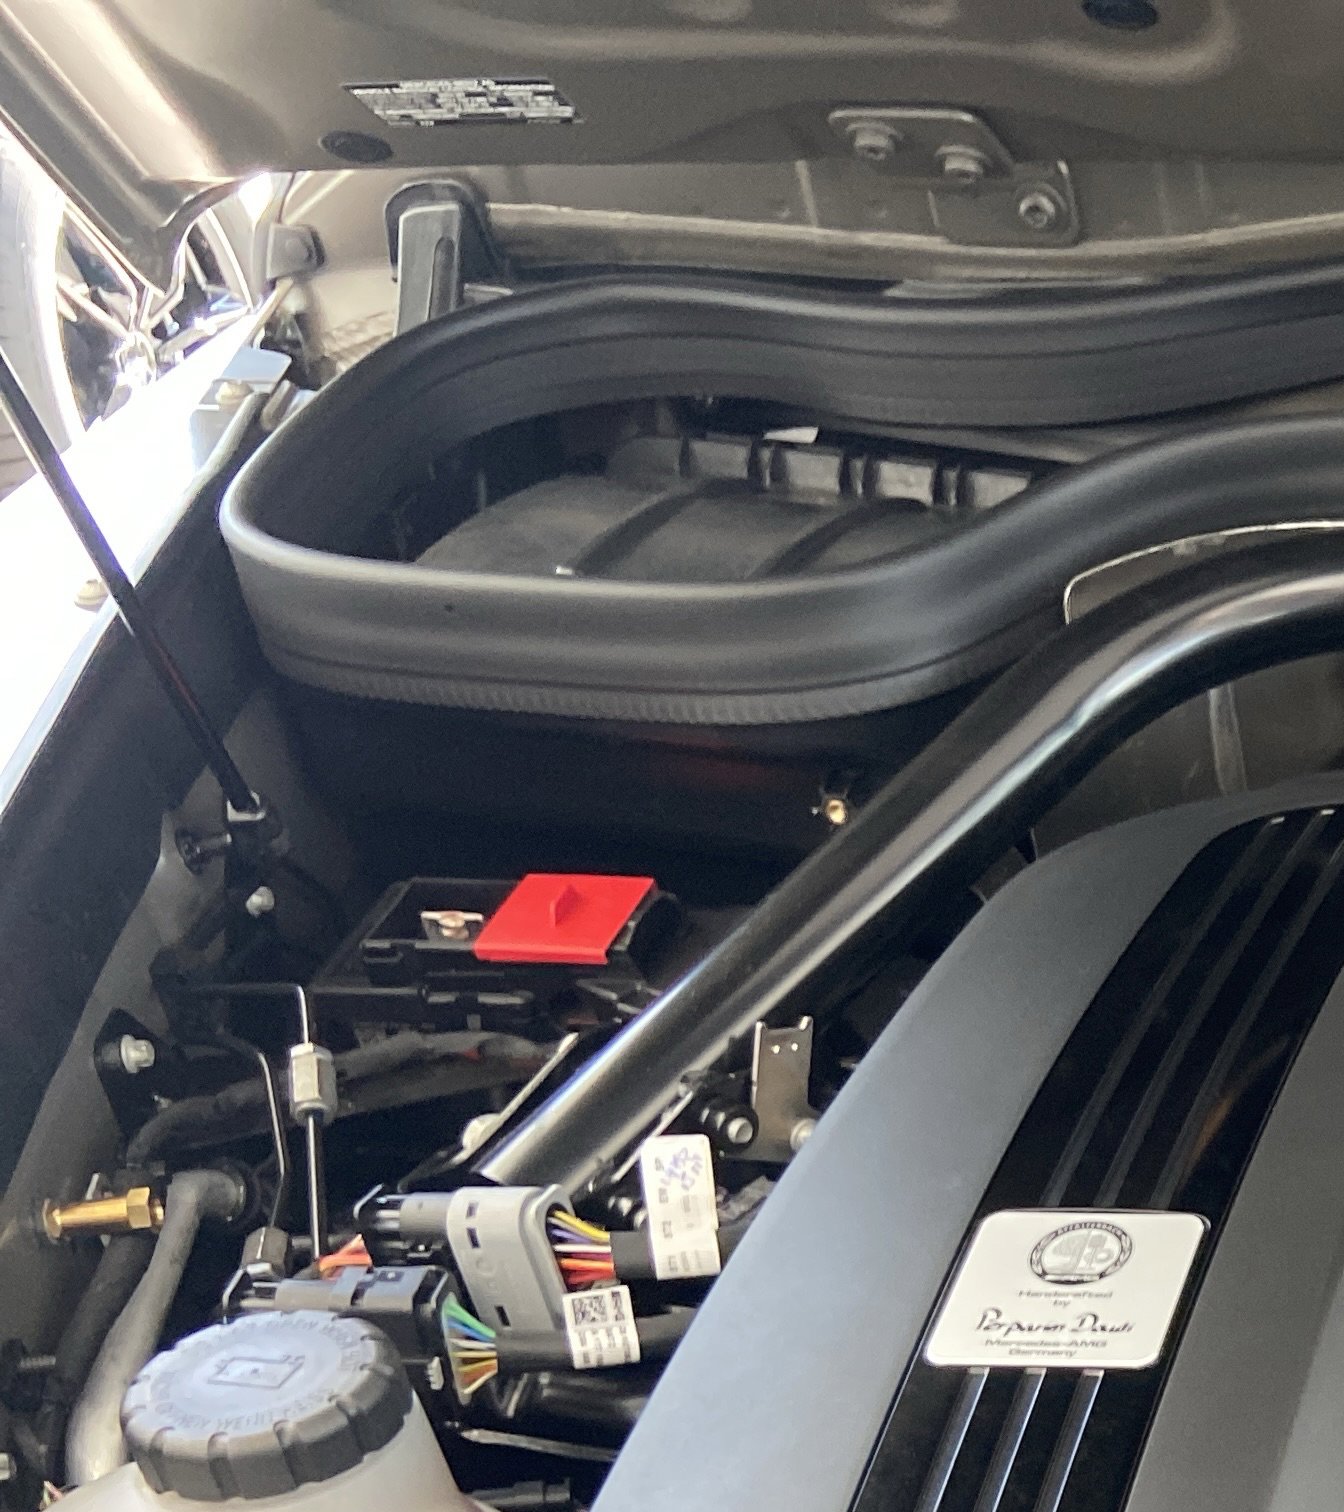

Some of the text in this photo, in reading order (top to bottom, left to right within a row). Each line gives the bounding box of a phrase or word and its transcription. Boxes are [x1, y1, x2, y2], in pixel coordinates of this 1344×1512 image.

[1018, 1290, 1113, 1300] Handcrafted
[1053, 1299, 1071, 1308] by
[985, 1339, 1107, 1349] Mercedes-AMG
[1009, 1348, 1077, 1358] Germany
